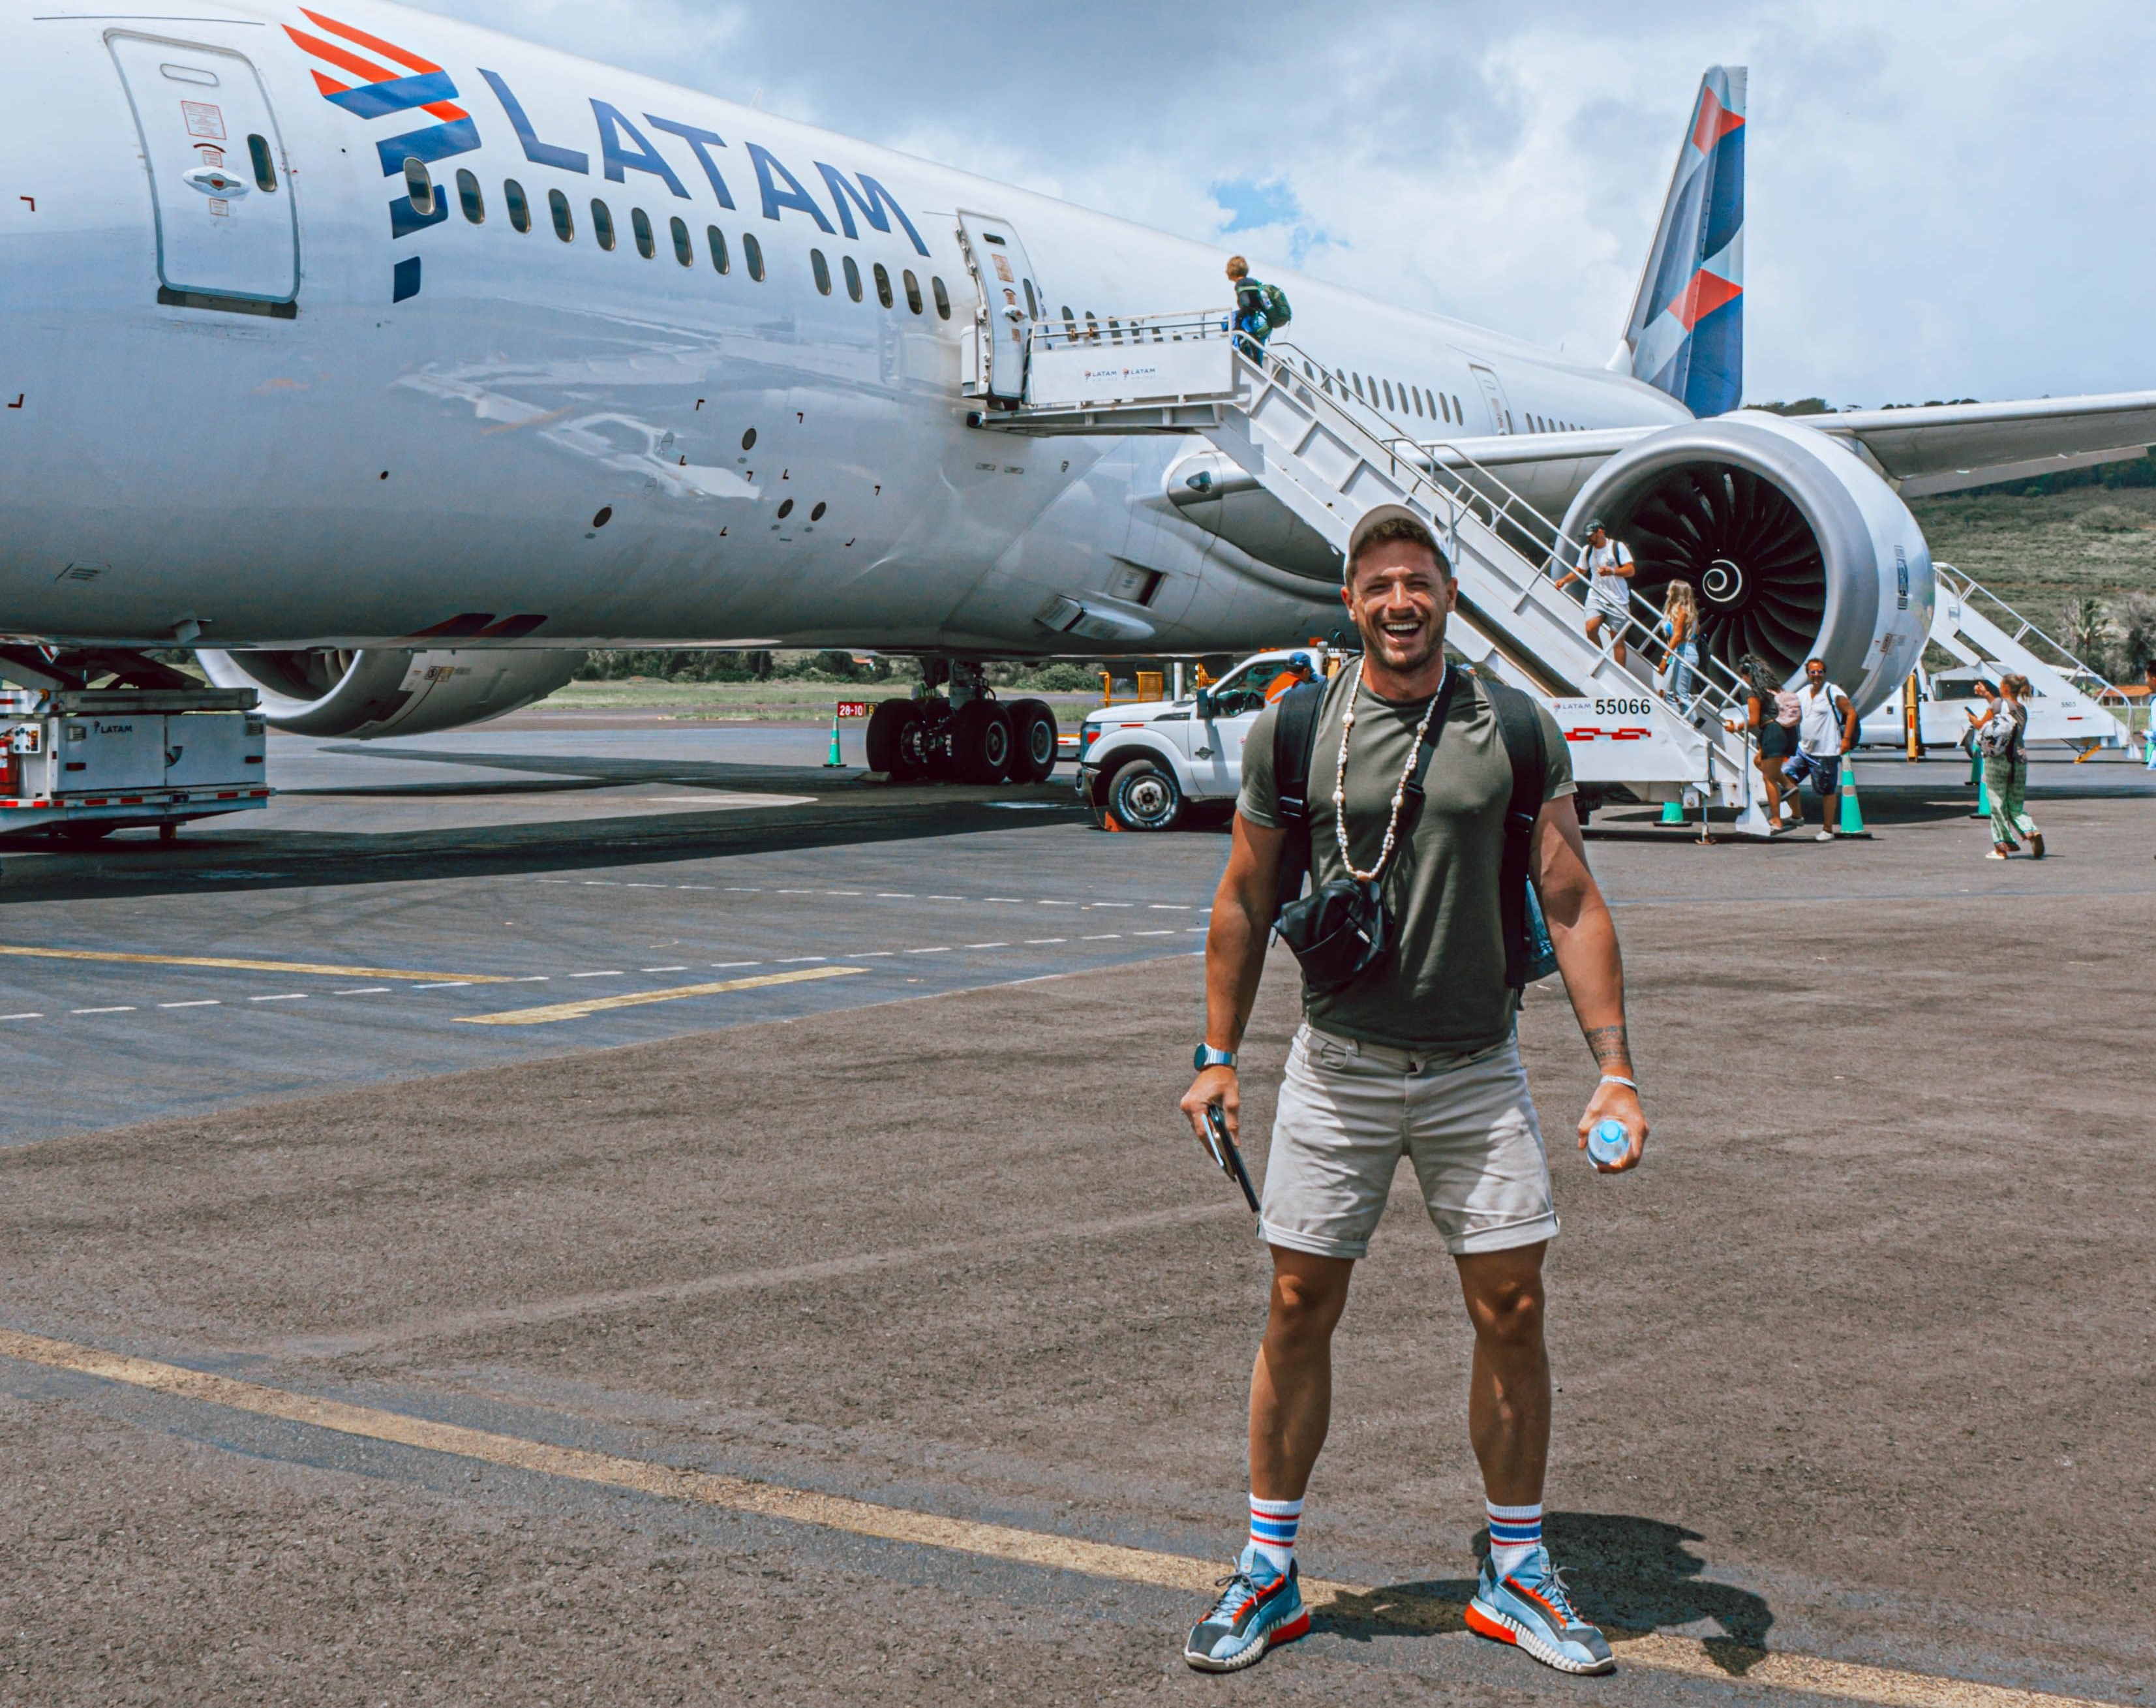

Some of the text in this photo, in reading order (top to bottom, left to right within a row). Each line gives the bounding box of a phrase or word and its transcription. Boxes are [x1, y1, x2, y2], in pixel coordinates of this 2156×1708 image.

[477, 67, 930, 257] LATAM
[840, 705, 863, 716] 28-10
[1595, 699, 1651, 714] 55066
[100, 725, 132, 733] LATAM
